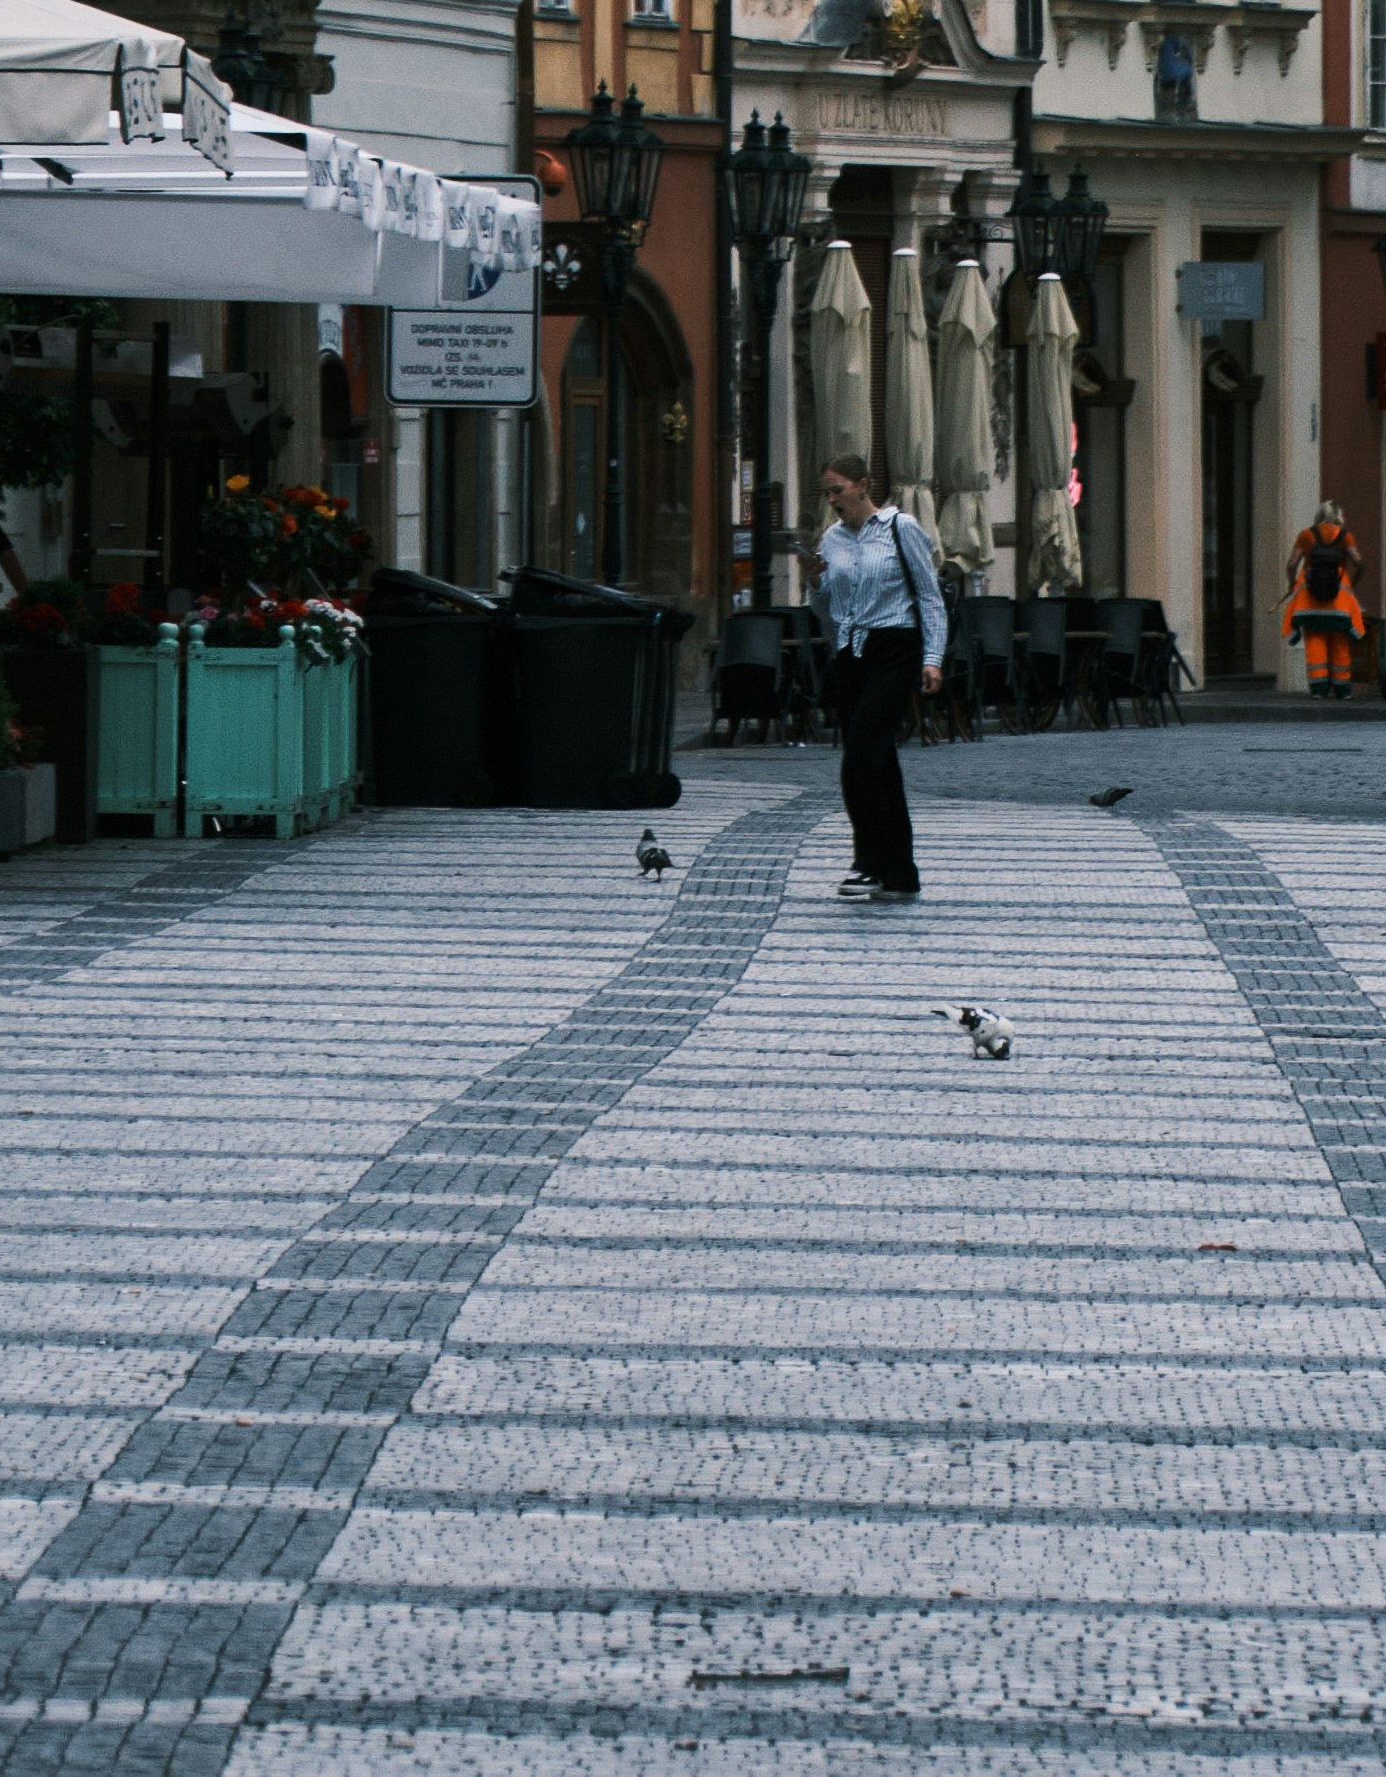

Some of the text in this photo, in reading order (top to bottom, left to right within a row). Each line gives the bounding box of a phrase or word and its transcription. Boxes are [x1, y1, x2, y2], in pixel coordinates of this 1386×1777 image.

[411, 323, 513, 335] DOPRAVNÍ OBSLUHA
[417, 338, 444, 348] MIMO
[448, 338, 469, 348] TAXI
[446, 366, 459, 375] SE
[462, 366, 525, 376] SOUHLASEM
[450, 379, 484, 389] PRAHA
